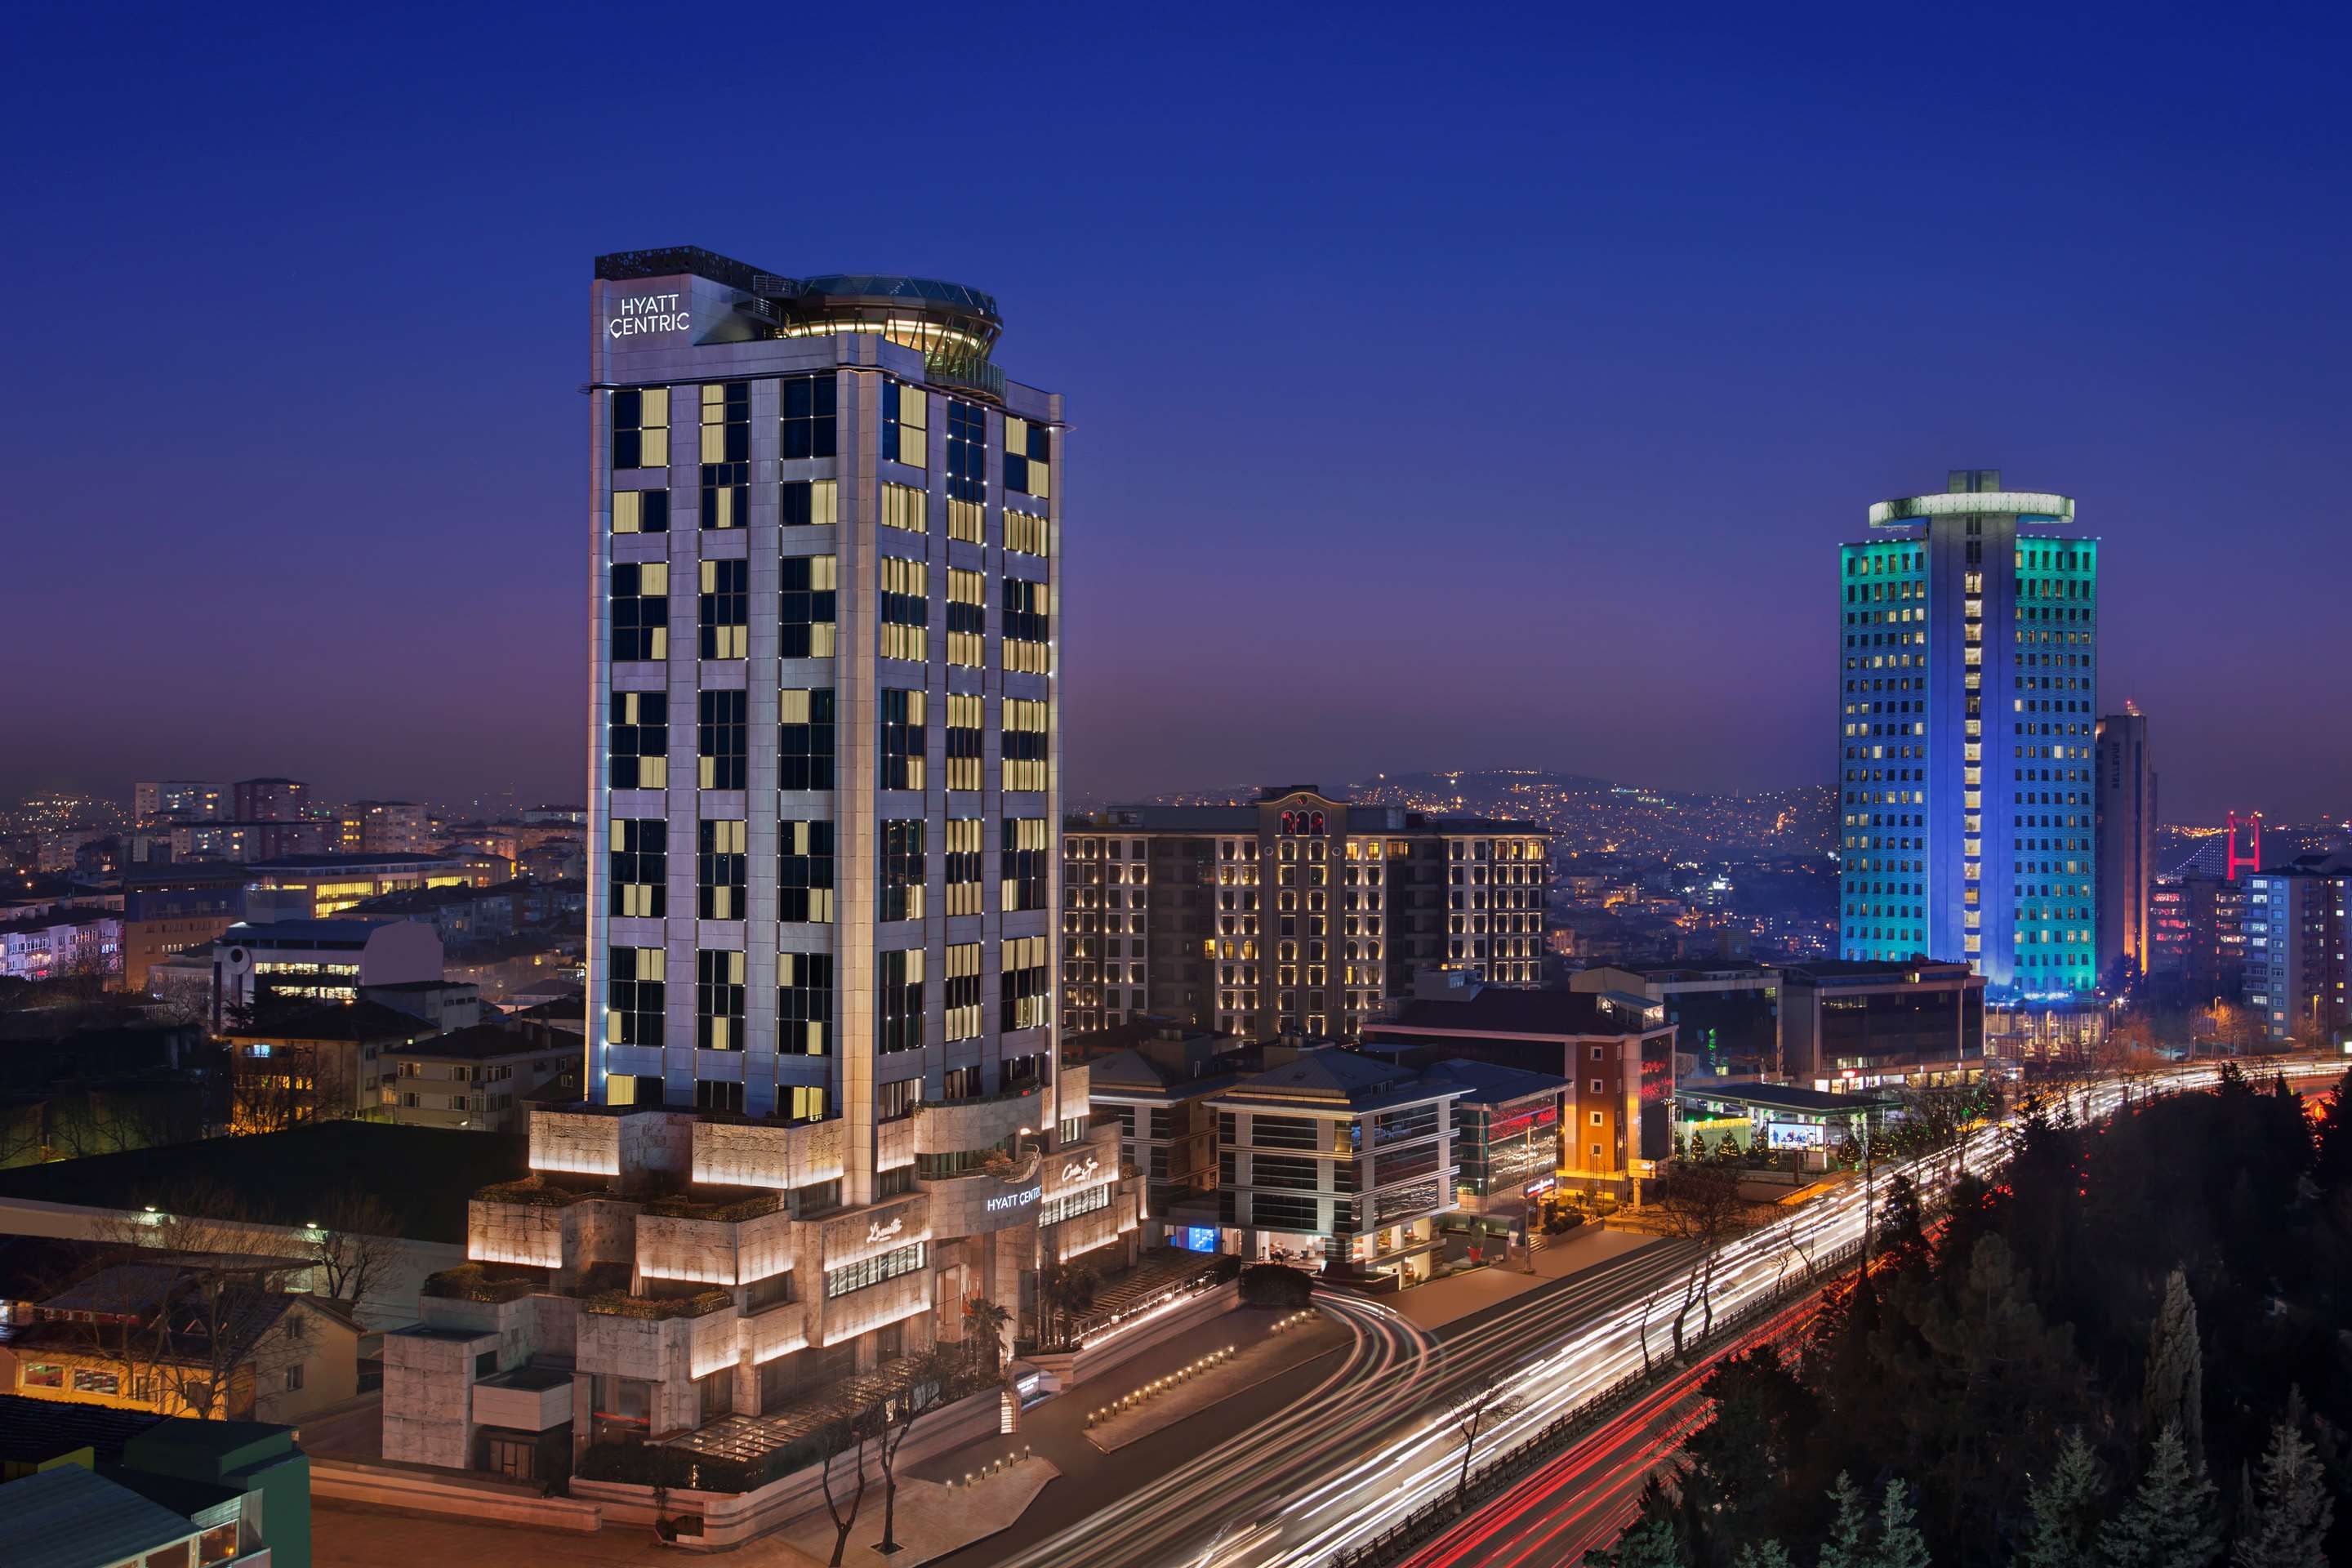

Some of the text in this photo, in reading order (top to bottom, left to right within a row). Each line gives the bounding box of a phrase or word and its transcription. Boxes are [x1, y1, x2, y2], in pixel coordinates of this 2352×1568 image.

[621, 294, 679, 315] HYATT
[610, 312, 689, 339] CENTRIC
[2110, 742, 2121, 789] BELLEVUE
[987, 1194, 1018, 1212] HYATT
